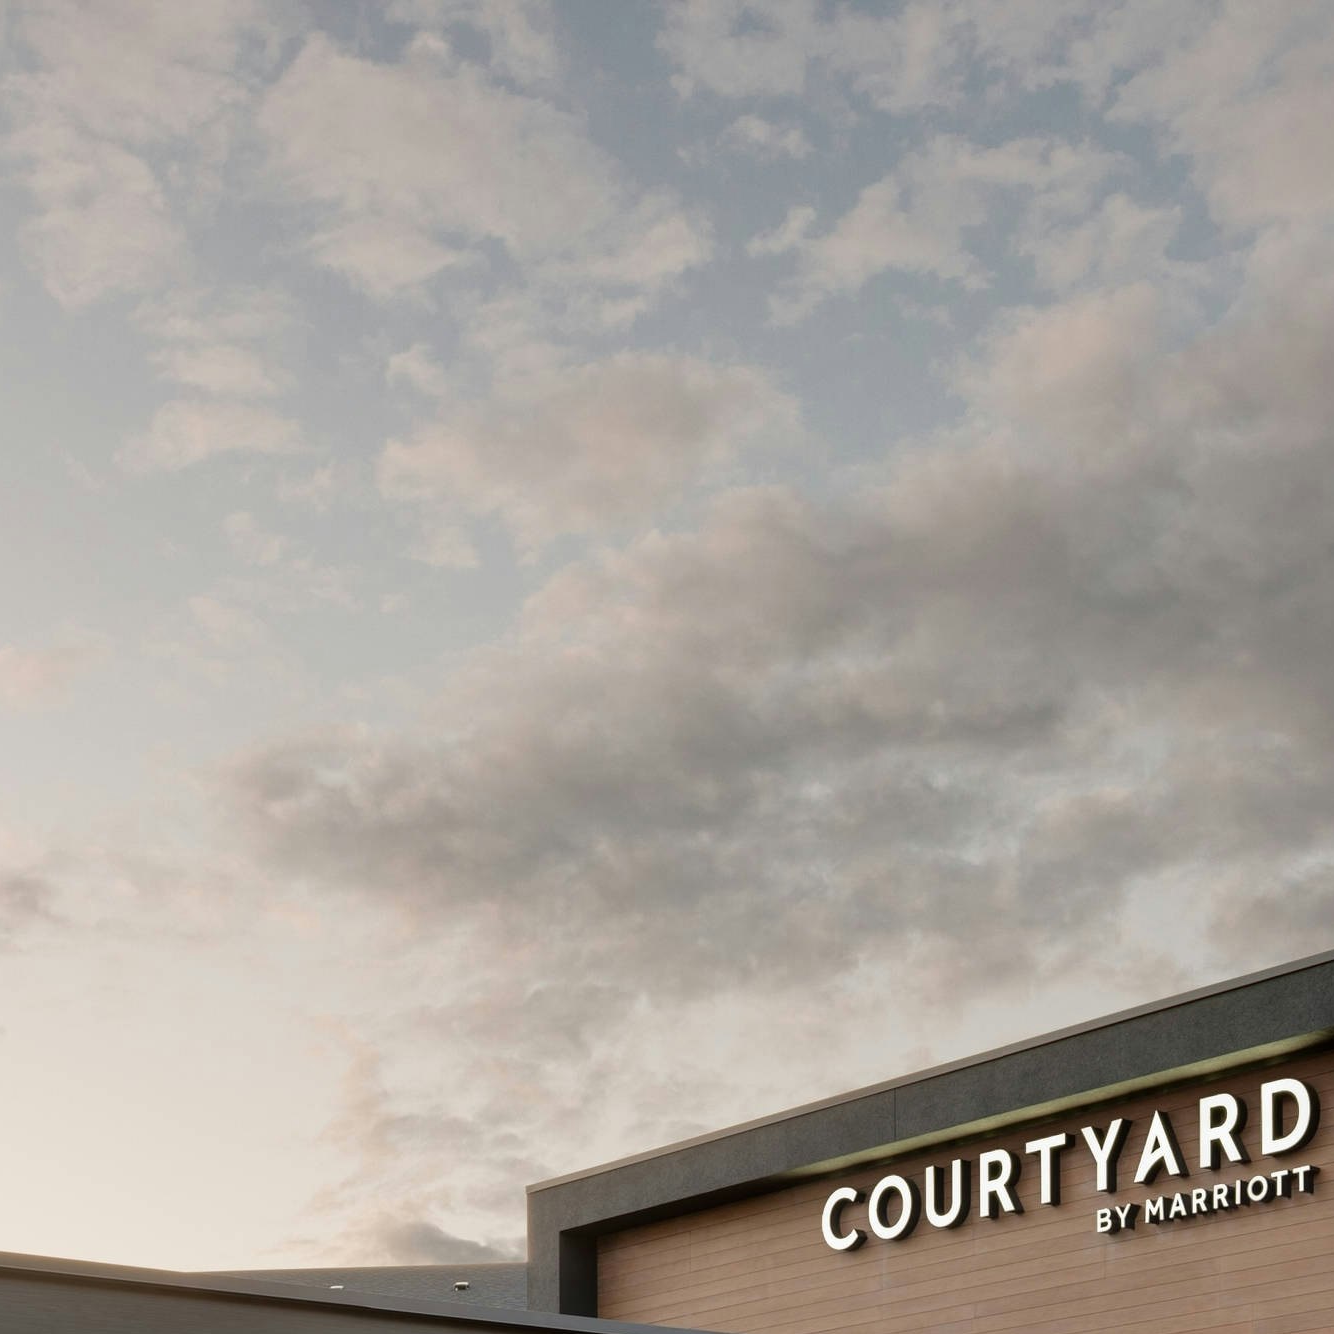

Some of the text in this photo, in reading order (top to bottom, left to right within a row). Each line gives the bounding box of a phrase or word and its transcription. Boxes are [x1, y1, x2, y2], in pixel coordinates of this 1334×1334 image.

[820, 1077, 1314, 1251] COURTYARD
[1096, 1164, 1313, 1234] BY MARRIOTT
